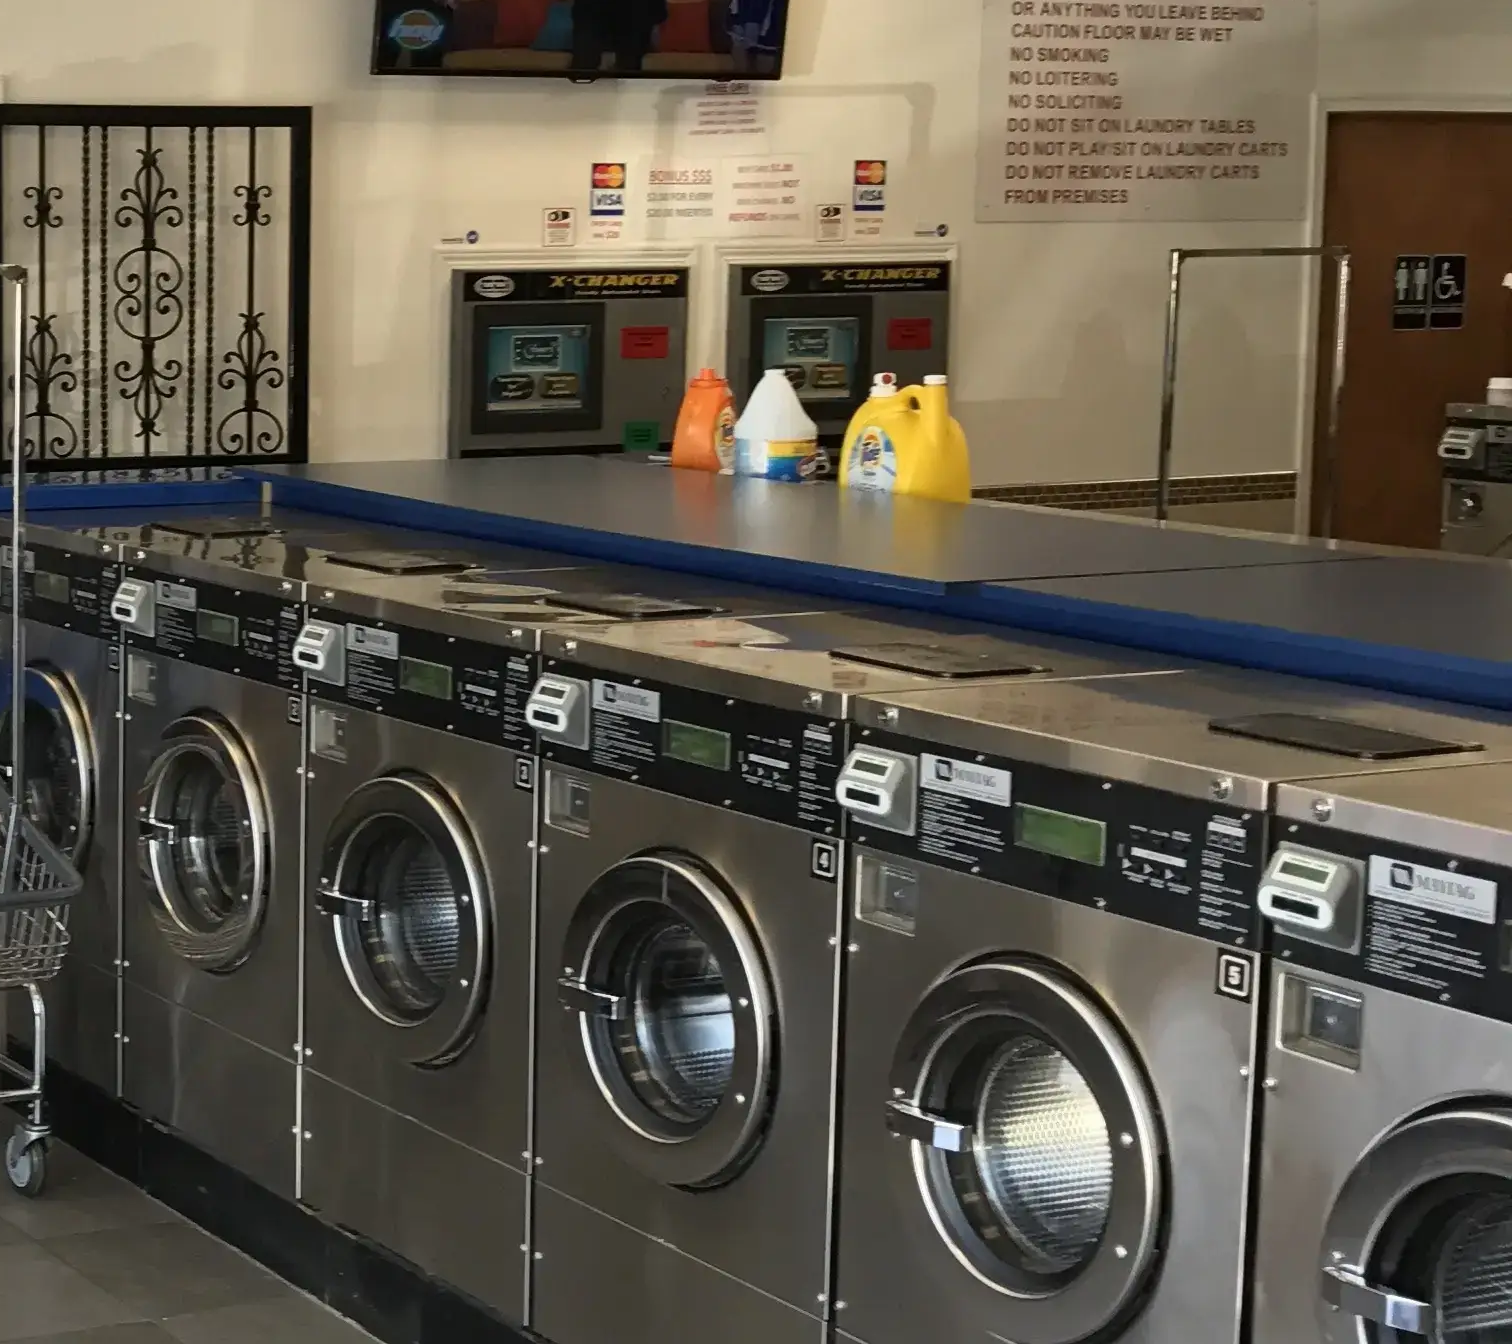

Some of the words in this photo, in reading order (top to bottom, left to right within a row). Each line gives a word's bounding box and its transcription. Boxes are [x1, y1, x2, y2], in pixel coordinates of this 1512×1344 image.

[1011, 1, 1035, 16] OR
[1040, 2, 1120, 18] ANYTHING
[1125, 4, 1155, 19] YOU
[1159, 5, 1208, 20] LEAVE
[1211, 6, 1265, 22] BEHIND
[1011, 23, 1080, 38] CAUTION
[1084, 24, 1136, 39] FLOOR
[1140, 26, 1171, 40] MAY
[1175, 27, 1196, 41] BE
[1200, 27, 1233, 42] WET
[1010, 47, 1033, 62] NO
[1037, 47, 1110, 63] SMOKING
[1009, 70, 1032, 85] NO
[1036, 71, 1119, 86] LOITERING
[1008, 94, 1031, 109] NO
[1035, 94, 1122, 110] SOLICITING
[1006, 118, 1030, 132] DO
[1034, 118, 1067, 132] NOT
[1070, 118, 1095, 133] SIT
[1098, 118, 1121, 133] ON
[1124, 119, 1194, 133] LAUNDRY
[1200, 119, 1256, 134] TABLES
[1006, 141, 1029, 156] DO
[1034, 141, 1066, 156] NOT
[1140, 142, 1162, 156] ON
[1166, 142, 1235, 156] LAUNDRY
[1238, 142, 1288, 156] CARTS
[1005, 165, 1028, 179] DO
[1033, 165, 1065, 179] NOT
[1068, 164, 1133, 179] REMOVE
[1136, 165, 1207, 179] LAUNDRY
[1210, 165, 1261, 179] CARTS
[595, 193, 623, 206] VISA
[1004, 189, 1049, 204] FROM
[1051, 189, 1129, 204] PREMISES
[548, 273, 680, 288] X-CHANGER
[819, 851, 829, 868] 4
[1228, 964, 1241, 985] 5
